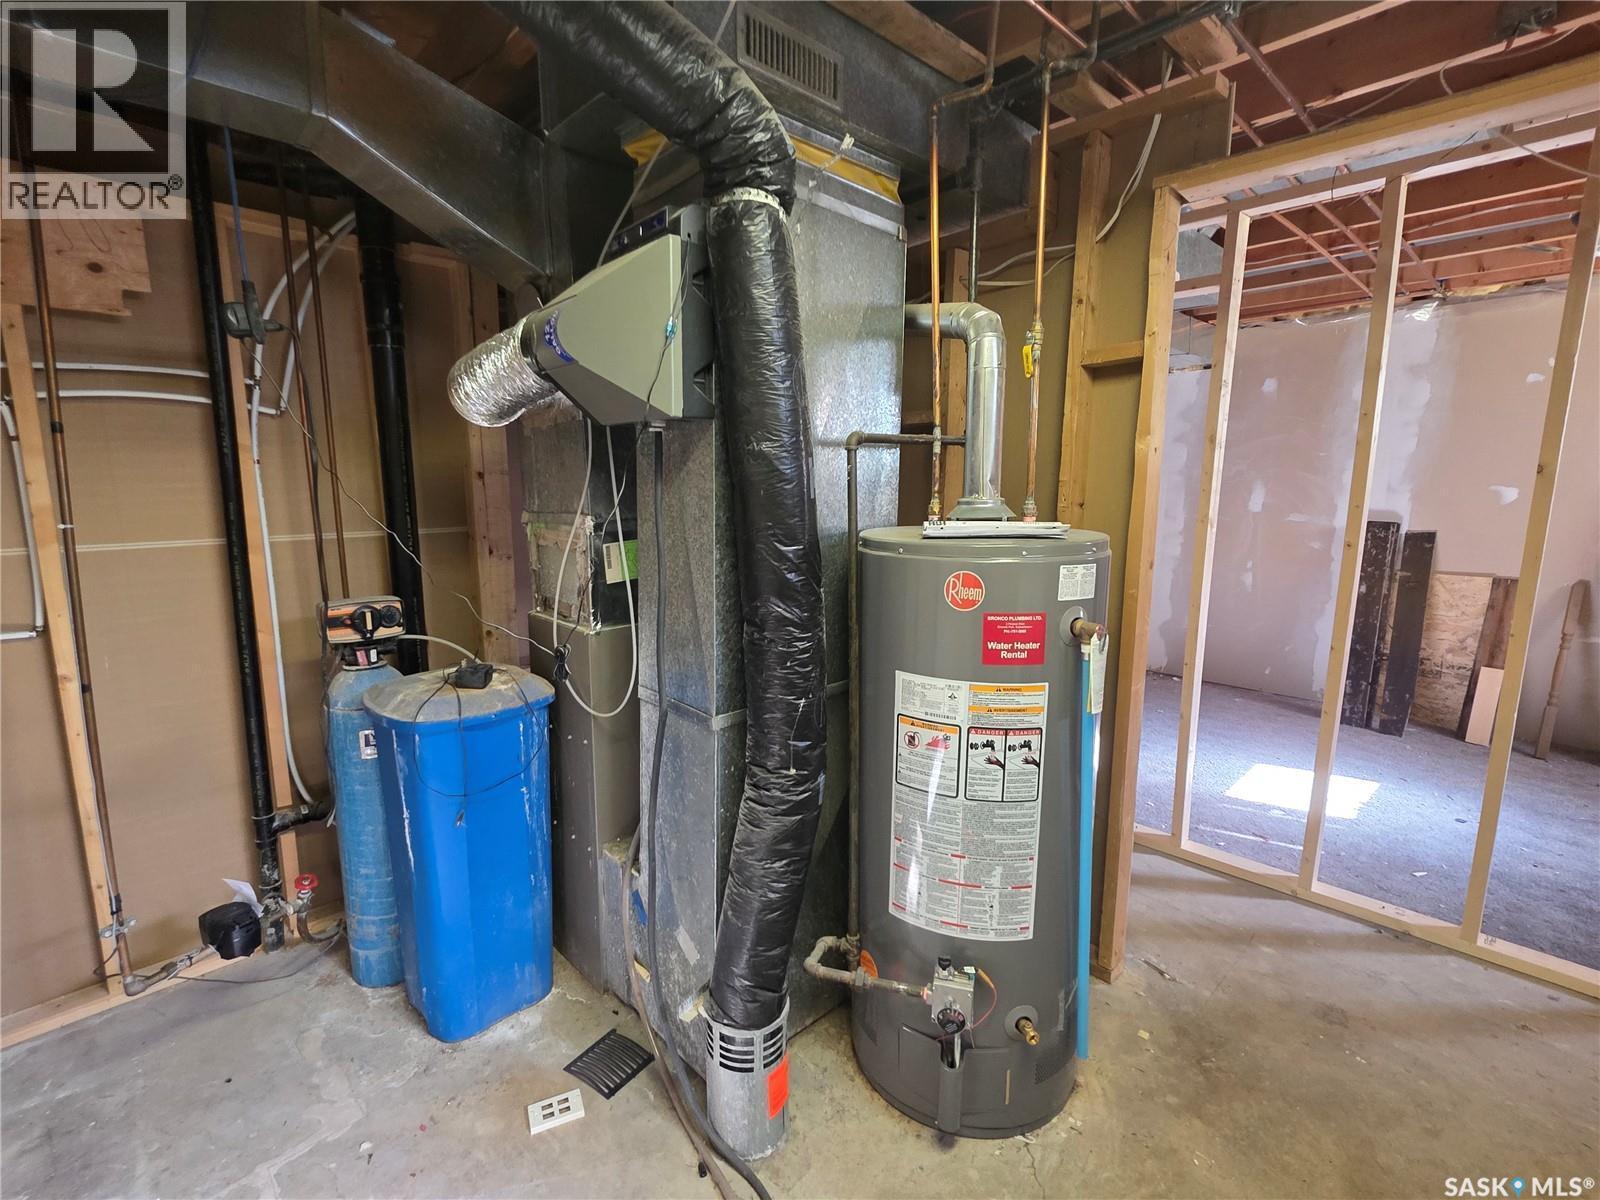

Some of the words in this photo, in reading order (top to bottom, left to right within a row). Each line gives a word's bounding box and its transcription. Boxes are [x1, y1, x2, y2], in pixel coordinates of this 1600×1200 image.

[948, 571, 982, 605] Rheem
[987, 641, 1012, 650] Water
[1014, 641, 1040, 650] Heater
[1001, 650, 1028, 659] Rental
